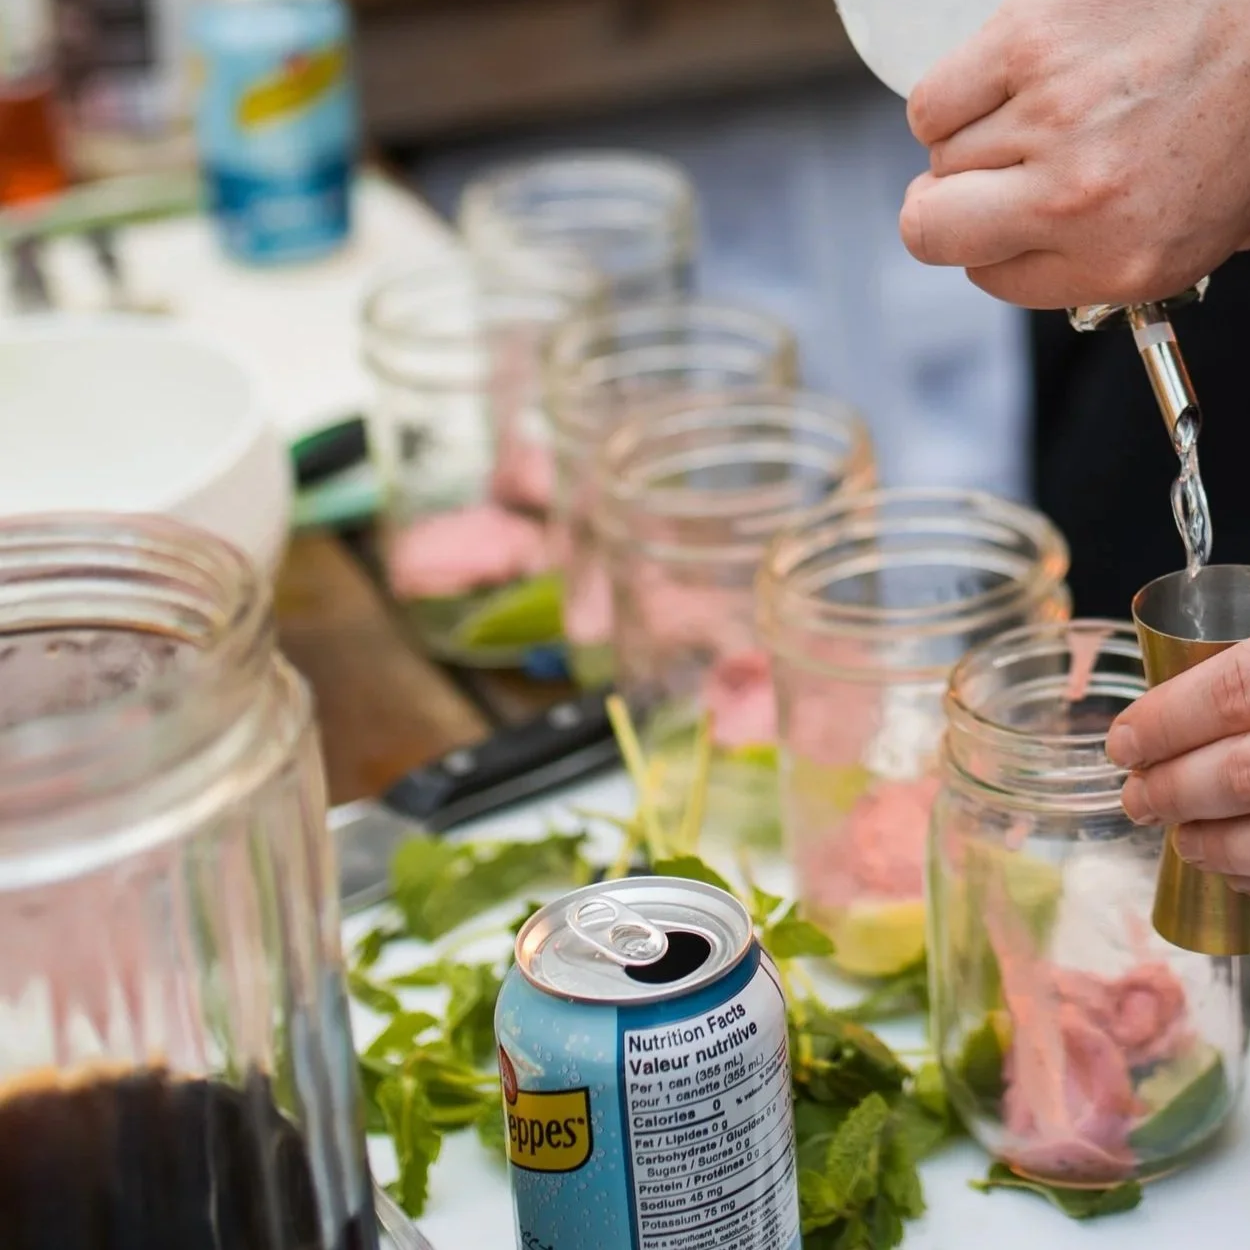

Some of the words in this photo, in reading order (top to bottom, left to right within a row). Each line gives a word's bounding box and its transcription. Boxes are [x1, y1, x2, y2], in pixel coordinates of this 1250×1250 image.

[628, 1025, 705, 1053] Nutrition
[706, 1003, 746, 1034] Facts
[629, 1054, 690, 1076] Valeur
[696, 1021, 758, 1064] nutritive
[630, 1083, 652, 1095] Per
[657, 1081, 663, 1091] 1
[668, 1076, 691, 1089] can
[695, 1067, 721, 1083] (355
[724, 1052, 745, 1071] mL)
[631, 1096, 660, 1111] pour
[665, 1094, 671, 1104] 1
[676, 1082, 720, 1101] canette
[723, 1065, 746, 1088] (355
[748, 1053, 764, 1072] mL)
[633, 1109, 696, 1129] Calories
[712, 1099, 721, 1111] 0
[634, 1138, 654, 1149] Fat
[665, 1128, 709, 1146] Lipides
[711, 1123, 719, 1133] 0
[722, 1119, 728, 1130] g
[636, 1140, 717, 1166] Carbohydrate
[726, 1115, 765, 1142] Glucides
[646, 1162, 687, 1178] Sugars
[699, 1147, 733, 1166] Sucres
[736, 1140, 742, 1150] 0
[744, 1137, 750, 1148] g
[639, 1181, 683, 1195] Protein
[694, 1159, 745, 1186] Protéines
[747, 1151, 753, 1162] 0
[640, 1197, 686, 1212] Sodium
[689, 1191, 704, 1203] 45
[707, 1185, 723, 1198] mg
[642, 1213, 701, 1230] Potassium
[704, 1207, 717, 1218] 75
[720, 1199, 736, 1213] mg
[643, 1241, 659, 1249] Not
